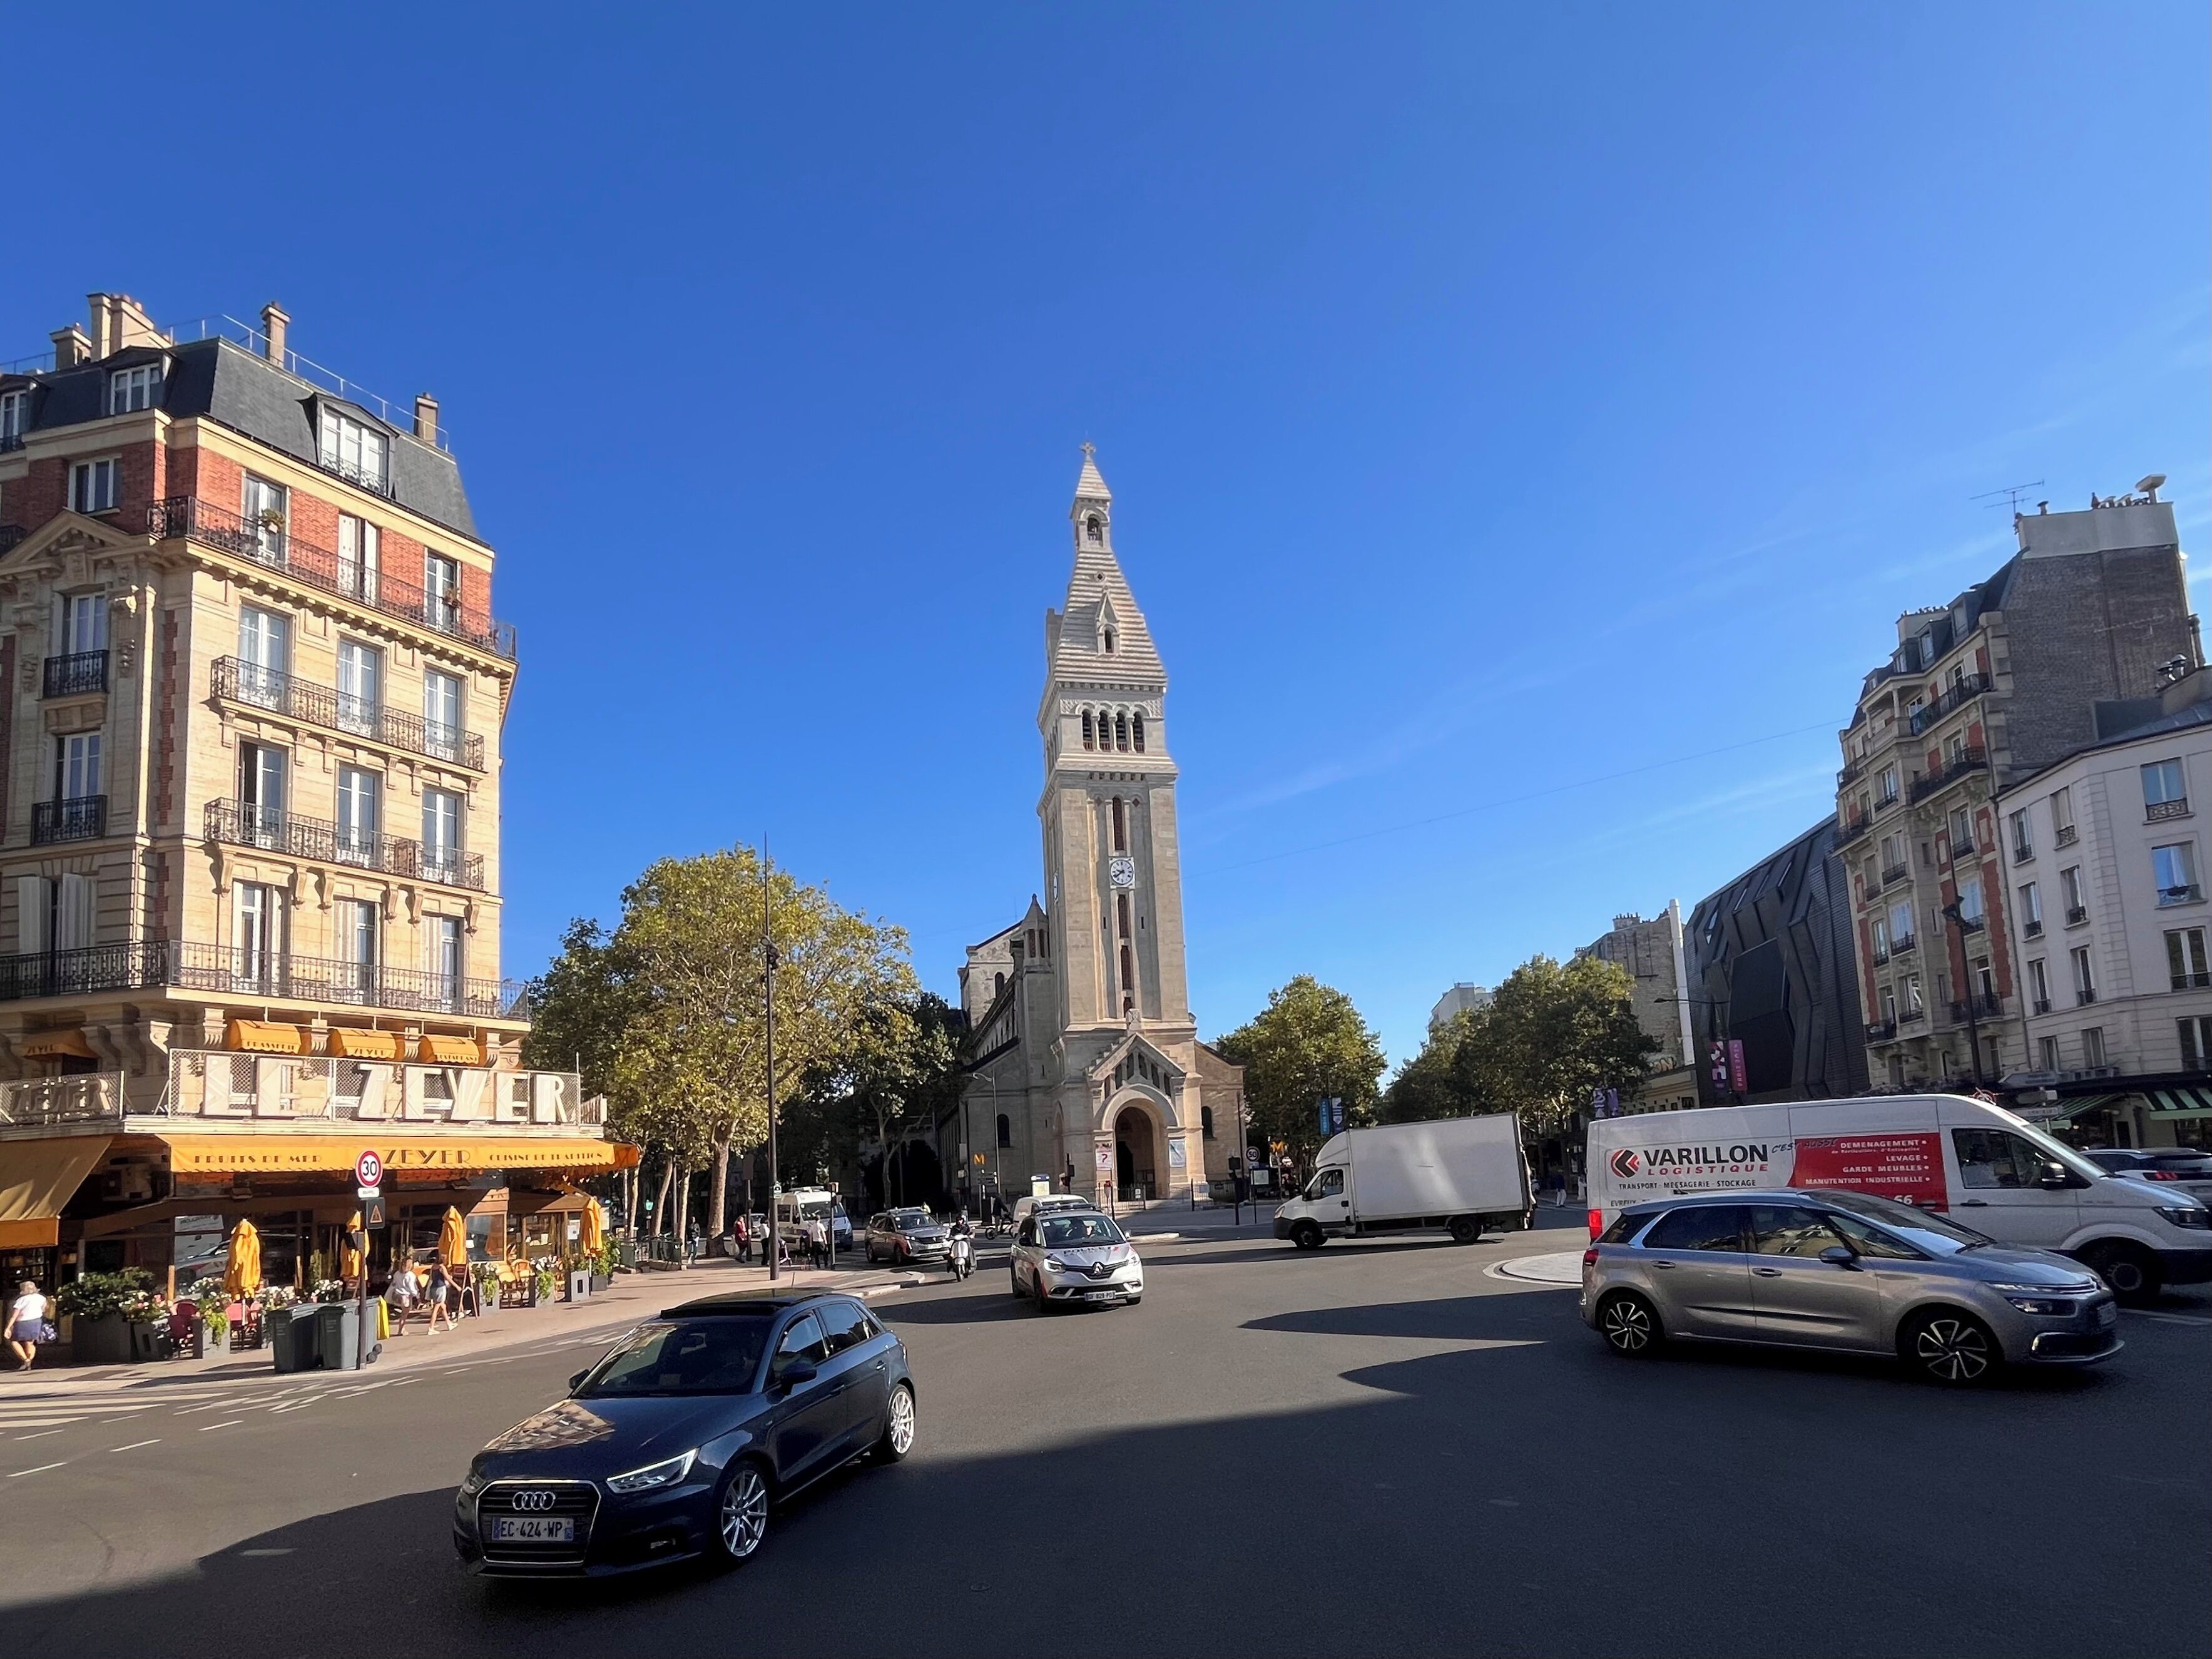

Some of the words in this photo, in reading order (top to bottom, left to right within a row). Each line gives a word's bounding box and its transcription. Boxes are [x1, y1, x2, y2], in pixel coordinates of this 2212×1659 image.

[203, 1054, 304, 1117] LE
[357, 1063, 573, 1123] ZEYER
[1840, 1140, 1919, 1149] DEMENAGEMENT
[383, 1149, 471, 1165] ZEYER
[973, 1153, 986, 1165] M
[1643, 1144, 1768, 1166] VARILLON
[362, 1160, 377, 1177] 30
[1647, 1163, 1769, 1176] LOGISTIQUE
[1878, 1164, 1922, 1172] MEUBLES
[1716, 1179, 1756, 1187] STOCKAGE
[1805, 1177, 1862, 1185] MANUTENTION
[1865, 1175, 1923, 1183] INDUSTRIELLE
